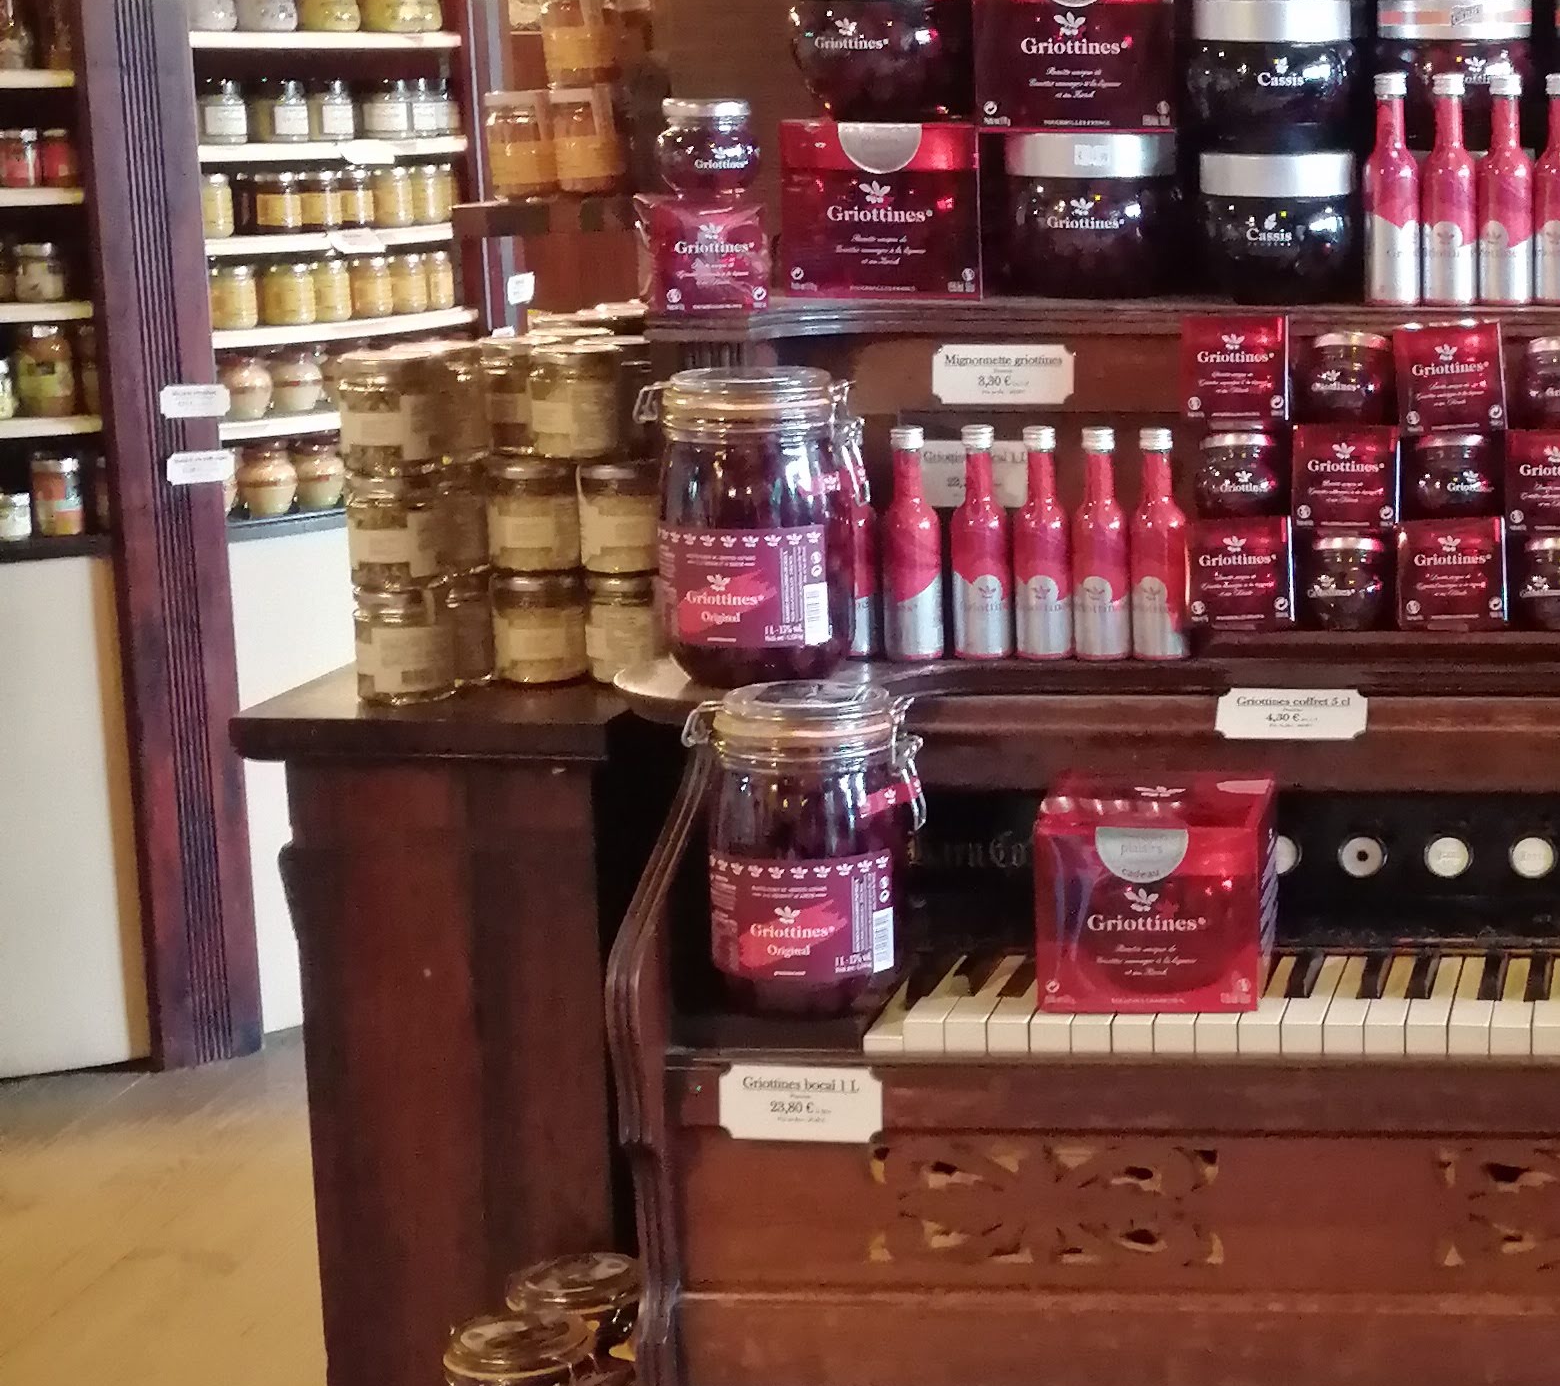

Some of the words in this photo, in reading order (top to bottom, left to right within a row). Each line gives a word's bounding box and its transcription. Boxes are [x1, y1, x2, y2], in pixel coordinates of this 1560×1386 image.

[1236, 696, 1290, 708] Griottines
[1086, 913, 1199, 932] Griottines
[742, 1075, 801, 1091] Griottines
[804, 1077, 836, 1092] bocal
[806, 1101, 814, 1114] €
